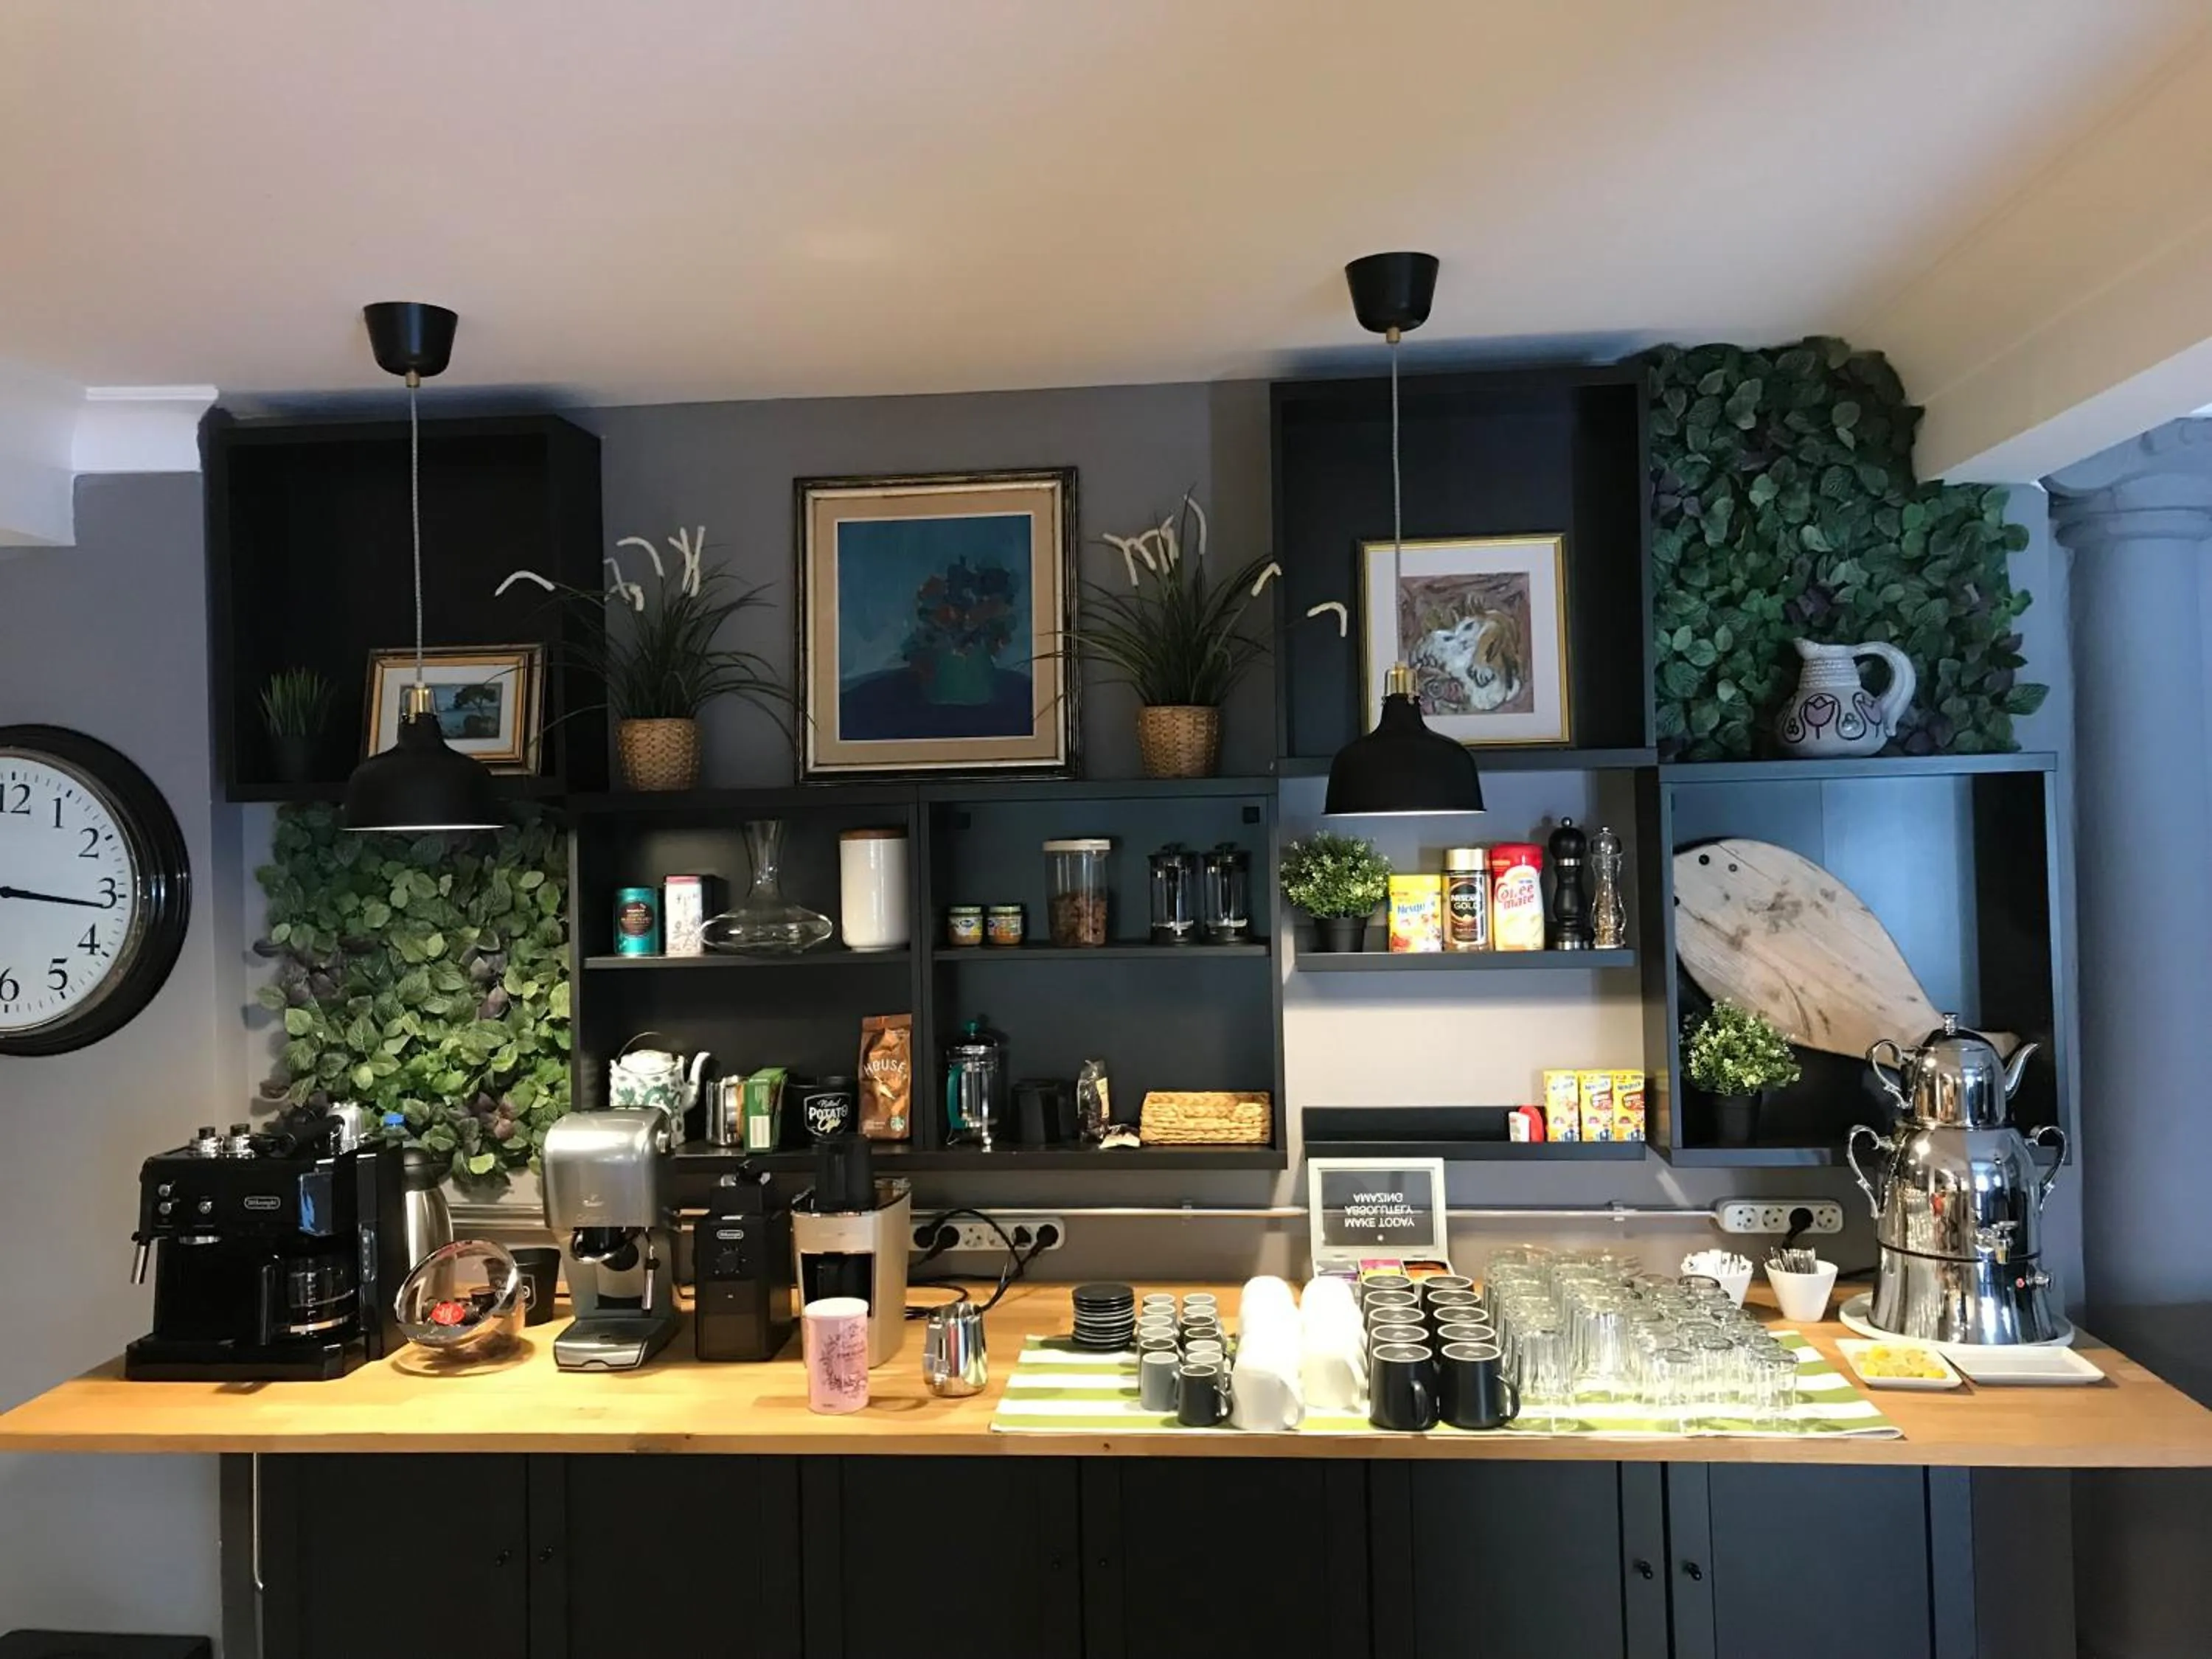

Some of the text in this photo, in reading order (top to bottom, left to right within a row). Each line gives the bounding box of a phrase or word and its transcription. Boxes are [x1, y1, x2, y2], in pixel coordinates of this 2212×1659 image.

[52, 797, 63, 828] 1
[78, 827, 100, 859] 2
[97, 877, 117, 908] 3
[77, 923, 101, 956] 4
[0, 967, 20, 1002] 6
[47, 958, 69, 991] 5
[863, 1058, 907, 1077] HOUSE
[808, 1105, 848, 1121] POTATO
